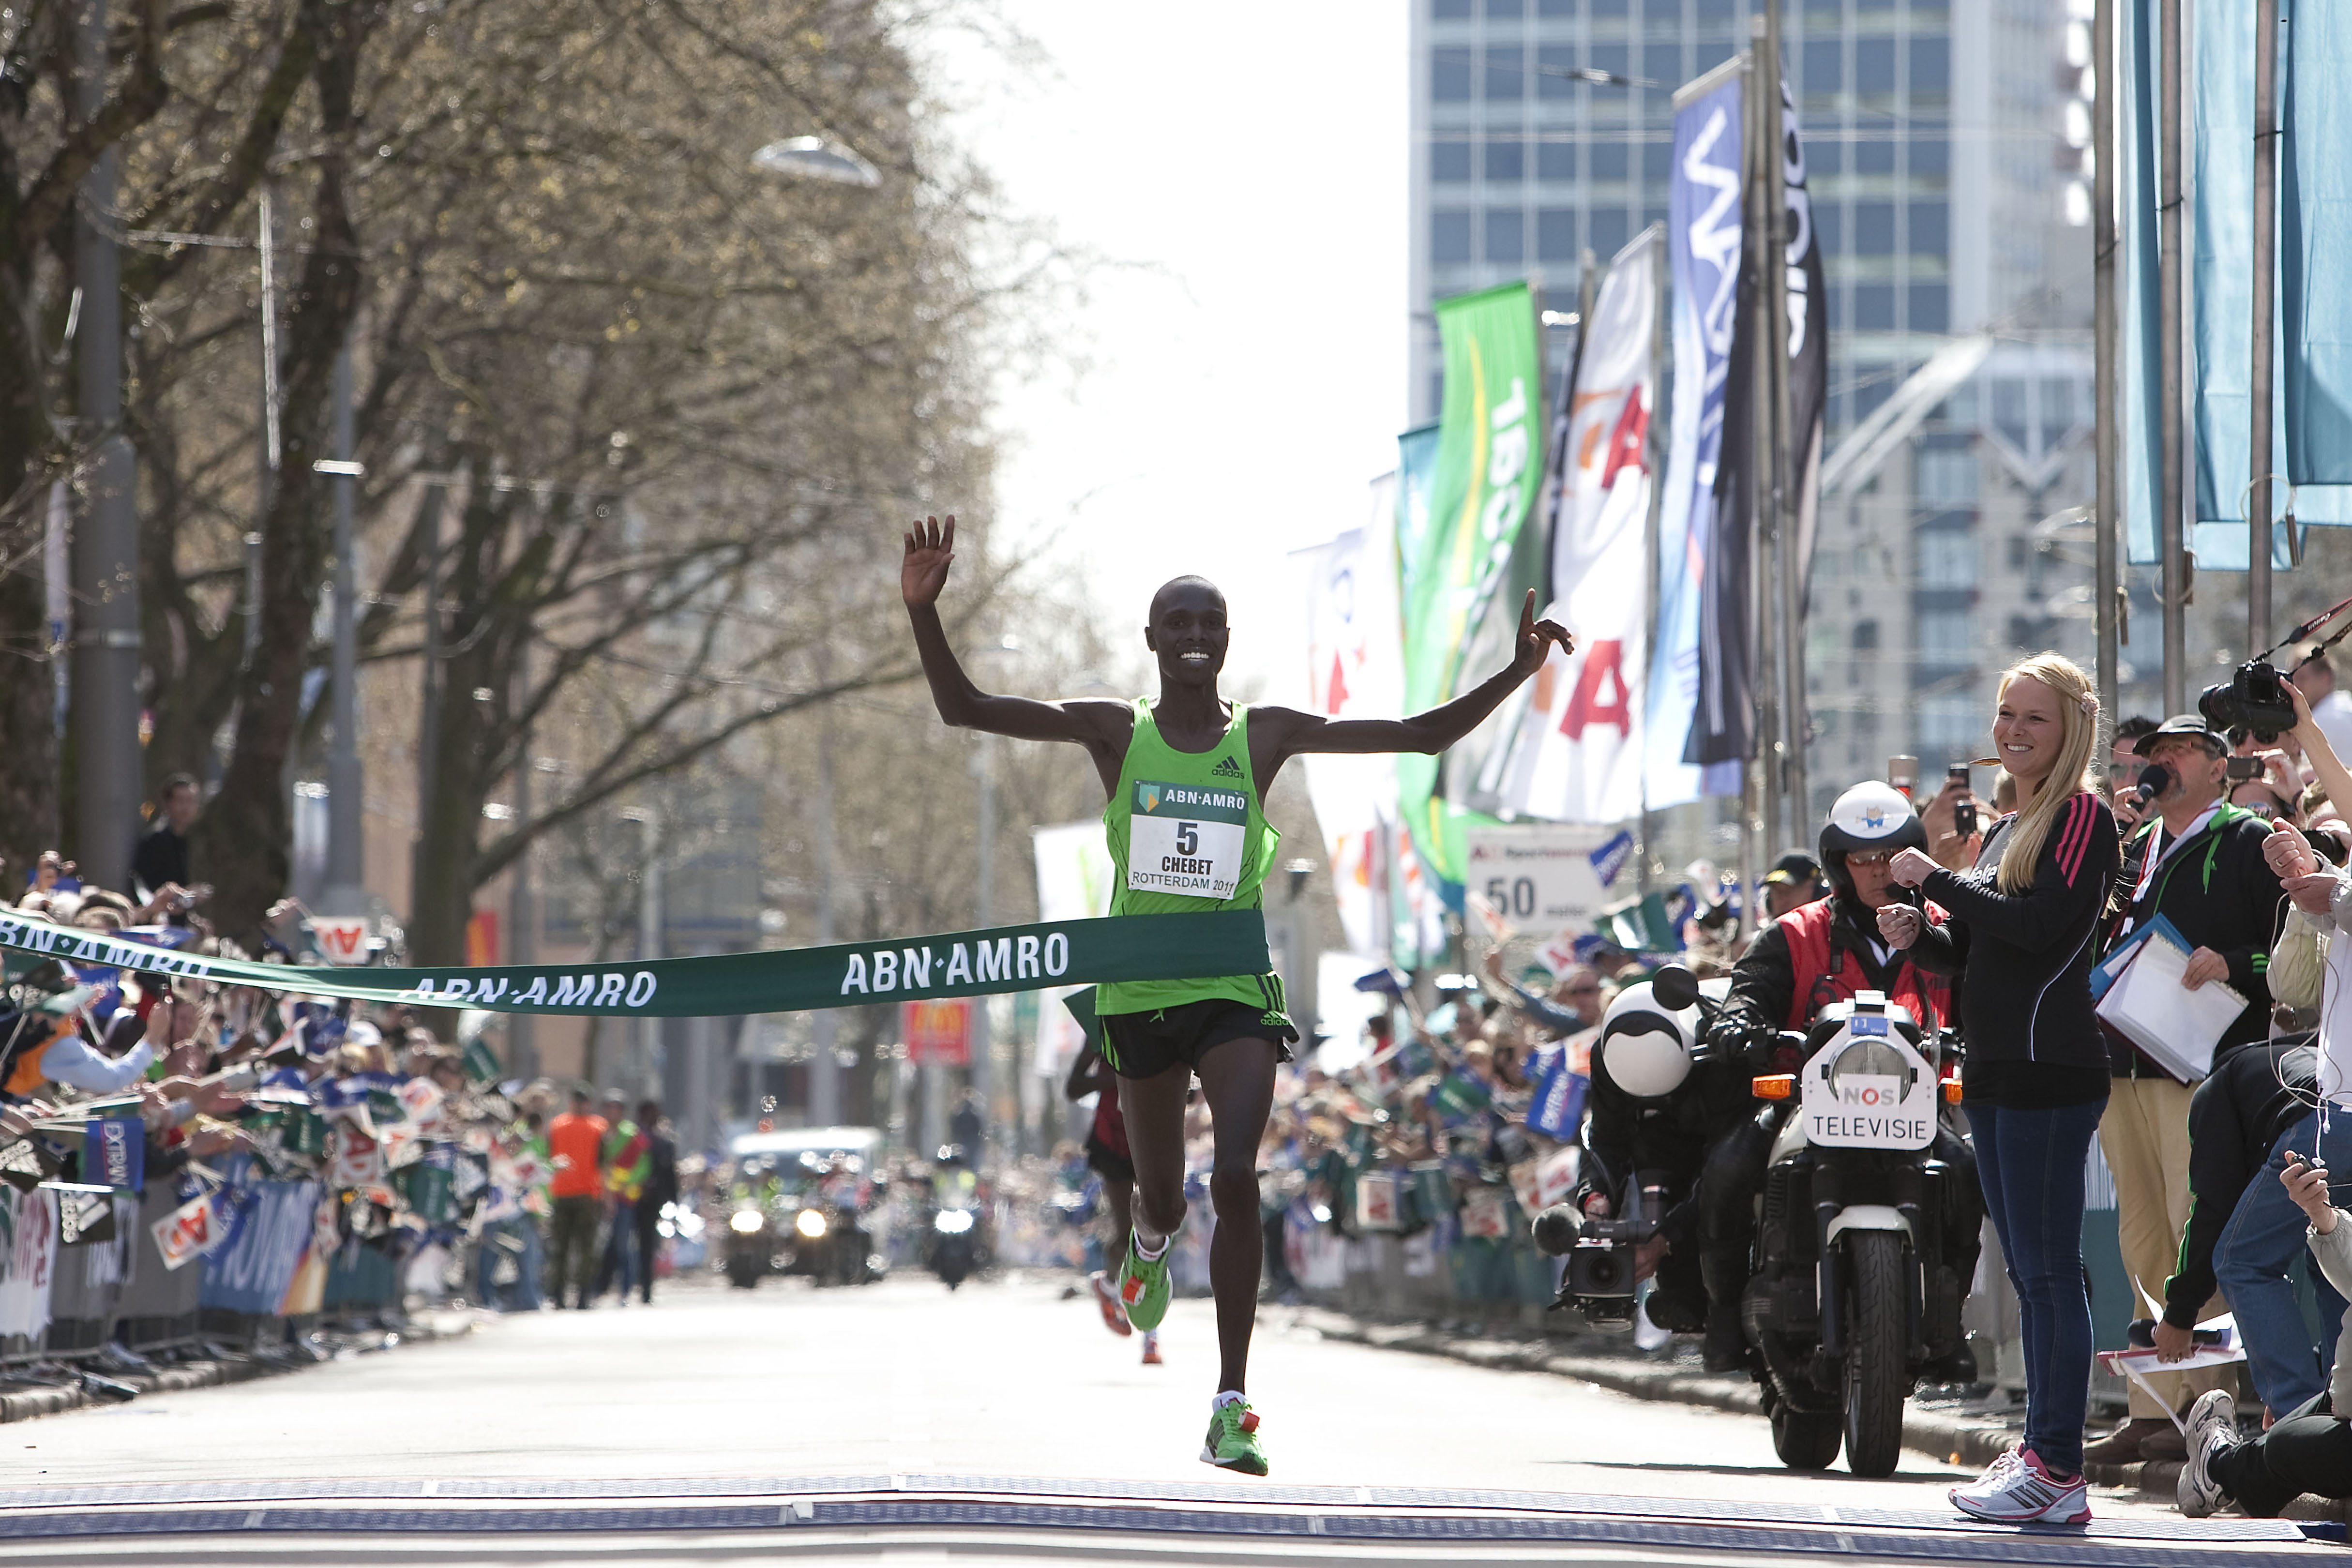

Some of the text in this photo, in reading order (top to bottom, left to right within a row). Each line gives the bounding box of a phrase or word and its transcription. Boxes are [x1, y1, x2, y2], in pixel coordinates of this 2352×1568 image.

[1211, 768, 1245, 779] adidas
[1176, 822, 1198, 856] 5
[1161, 856, 1213, 875] CHEBET
[1132, 872, 1235, 892] ROTTERDAM 2011
[1487, 876, 1535, 918] 50
[1260, 1017, 1289, 1026] adida
[1844, 1087, 1895, 1106] NOS
[1813, 1116, 1927, 1140] TELEVISIE
